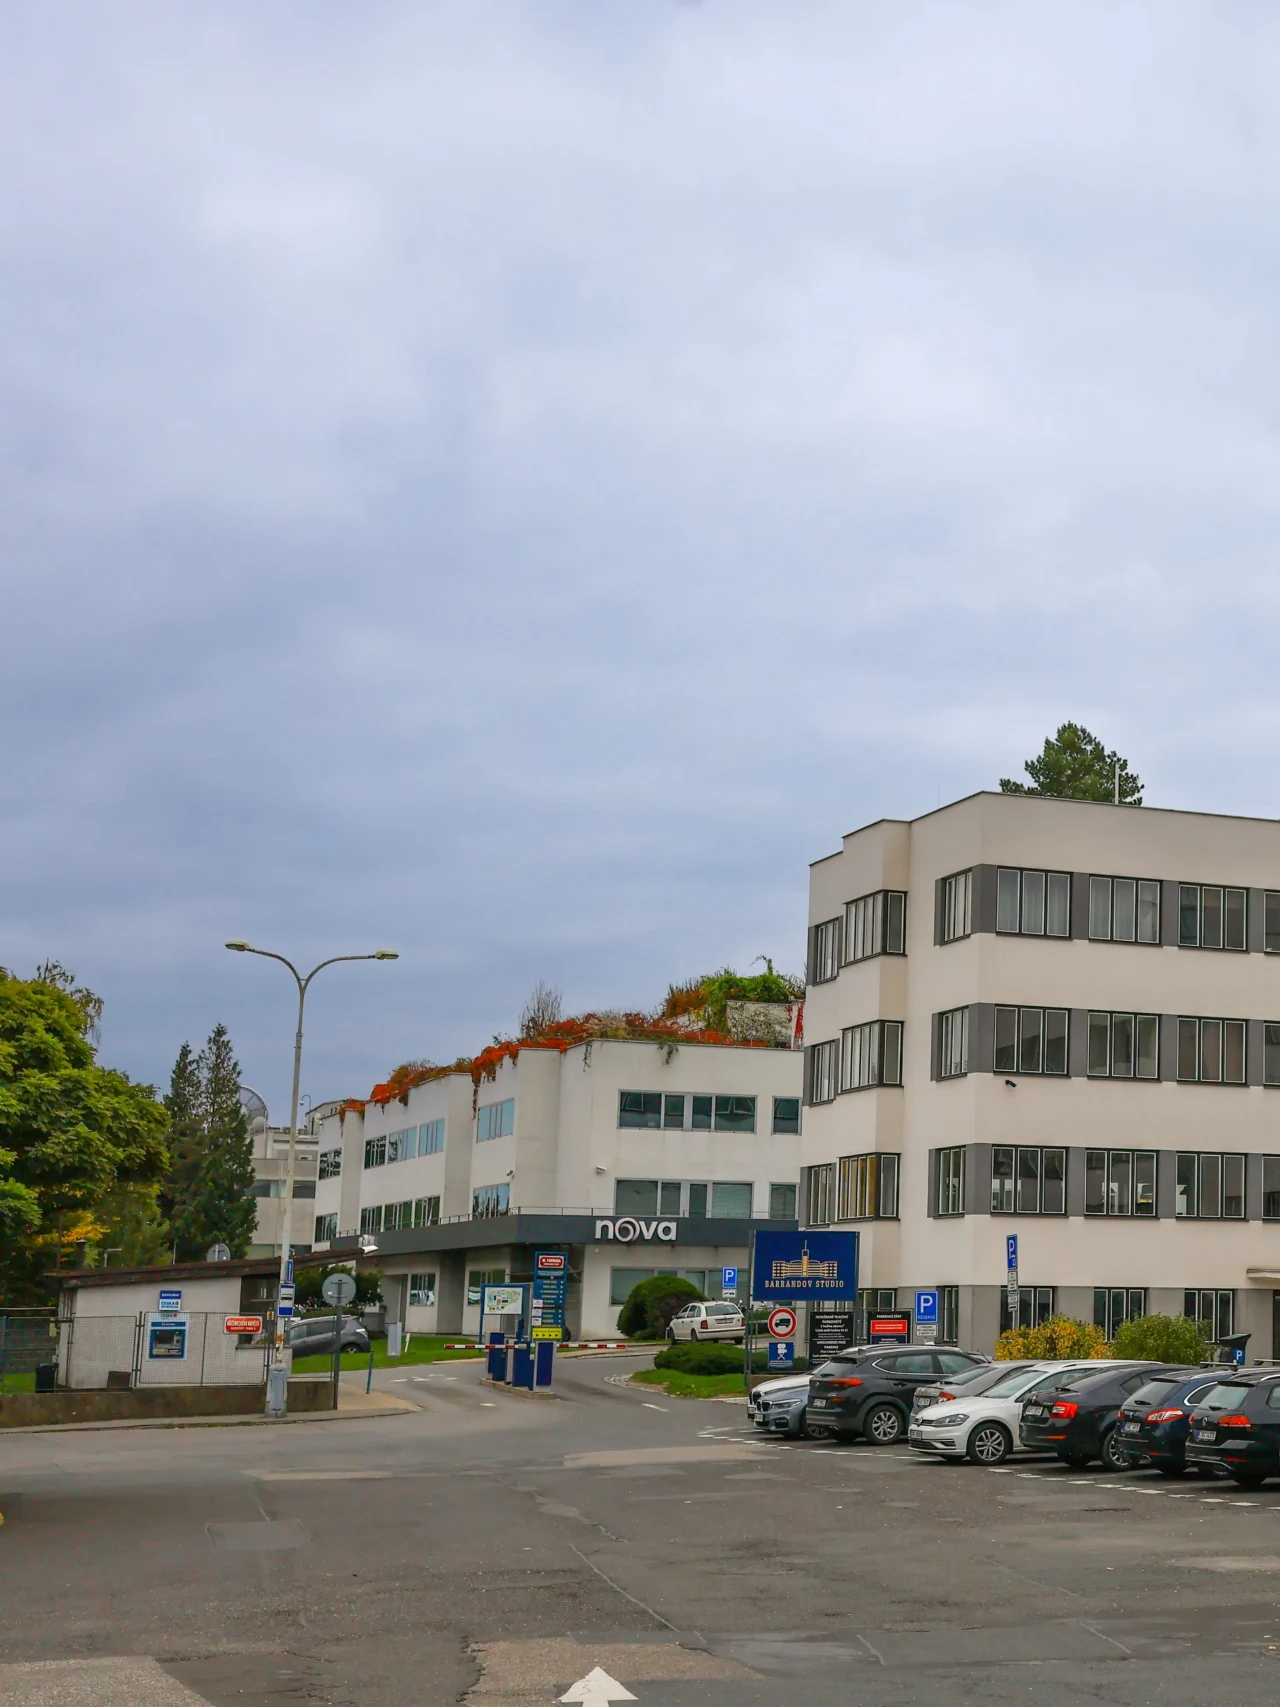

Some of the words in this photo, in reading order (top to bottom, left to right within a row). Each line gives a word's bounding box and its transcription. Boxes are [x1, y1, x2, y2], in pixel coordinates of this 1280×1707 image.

[594, 1218, 677, 1242] nova
[725, 1270, 734, 1281] P
[765, 1280, 813, 1288] BARRANDOV
[815, 1280, 845, 1288] STUDIO
[920, 1295, 933, 1314] P
[1236, 1351, 1242, 1360] P
